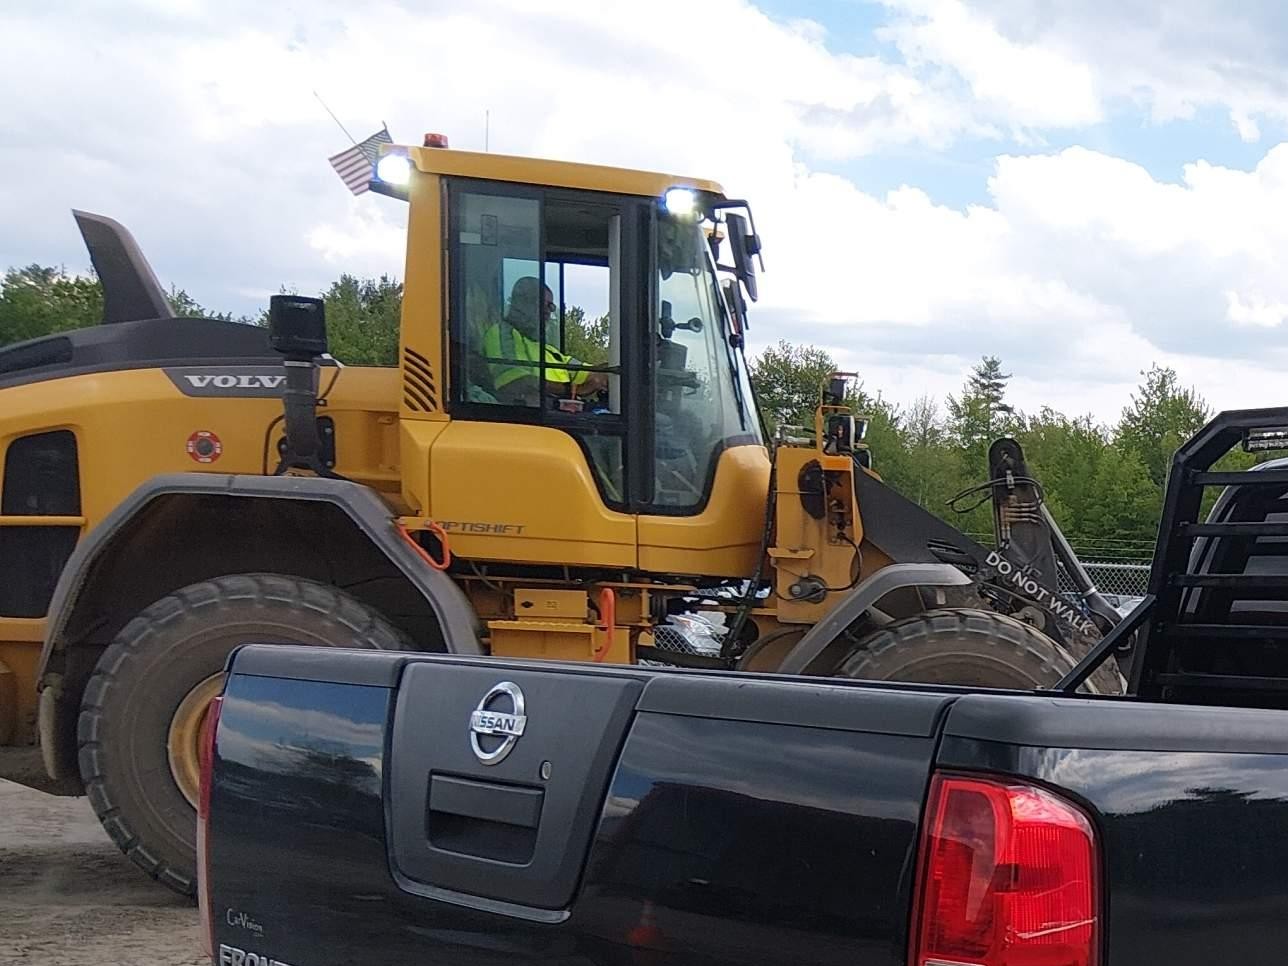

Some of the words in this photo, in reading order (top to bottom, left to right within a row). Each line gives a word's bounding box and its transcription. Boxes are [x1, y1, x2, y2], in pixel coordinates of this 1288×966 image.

[184, 375, 287, 388] VOLV
[985, 551, 1012, 575] DO
[1012, 571, 1049, 600] NOT
[1049, 597, 1094, 636] WALK
